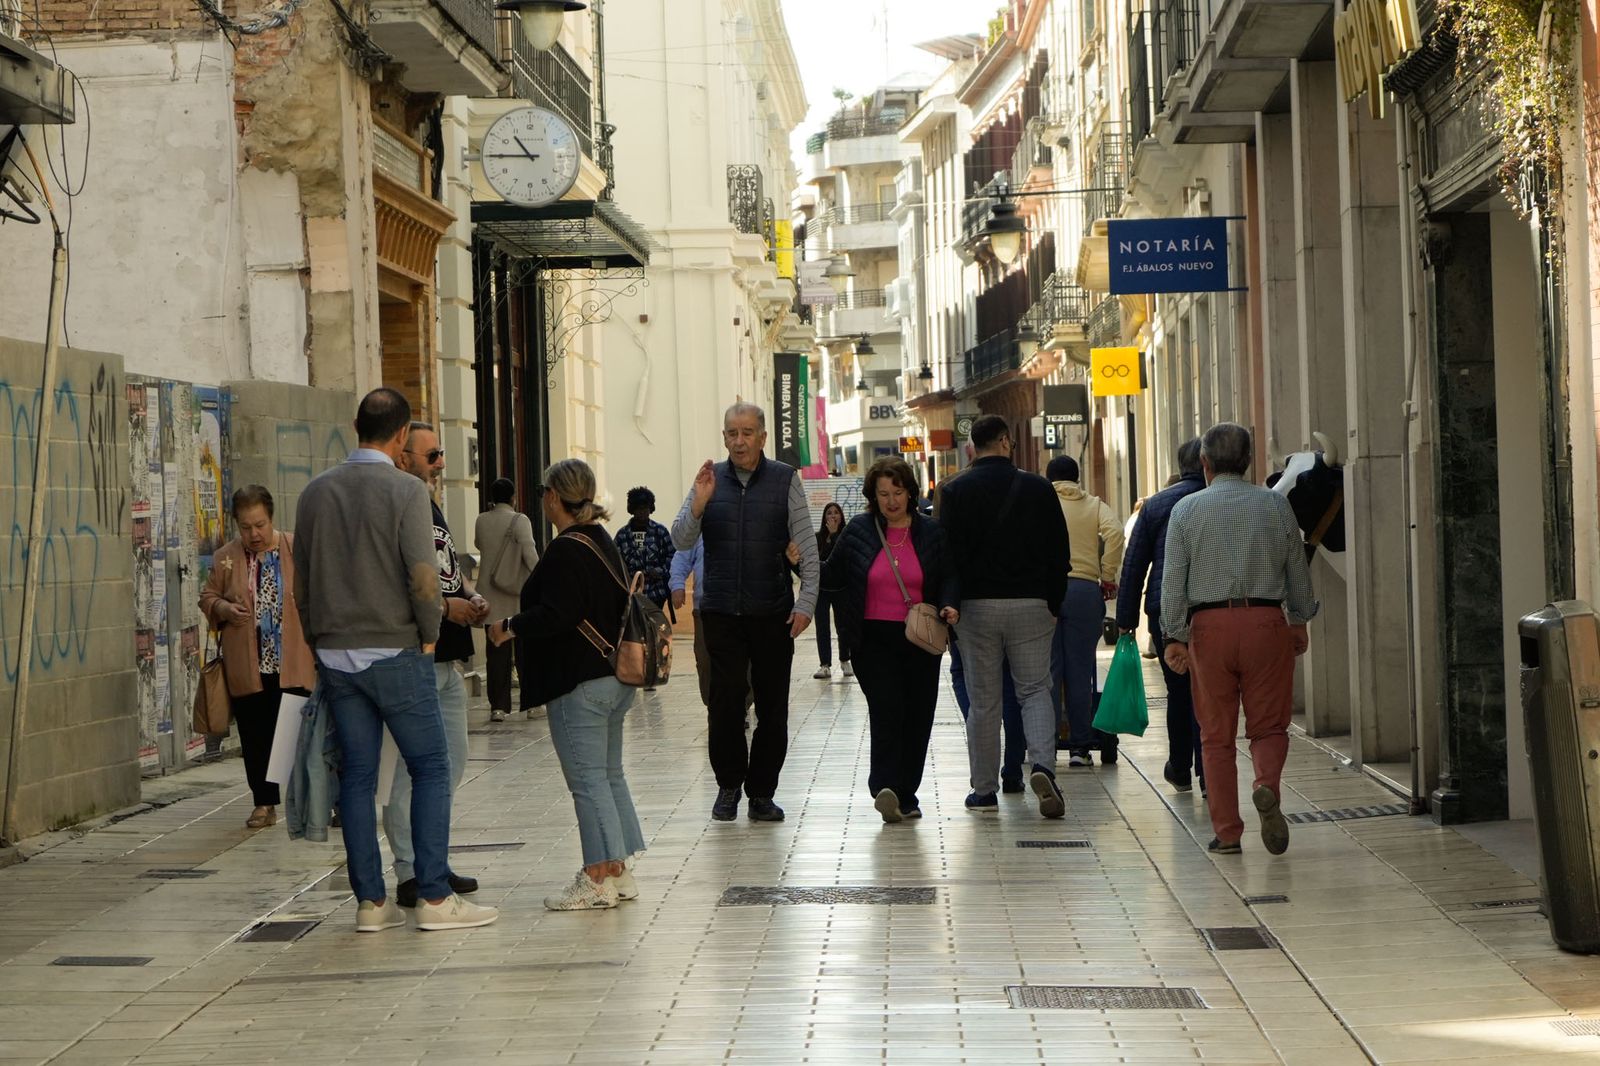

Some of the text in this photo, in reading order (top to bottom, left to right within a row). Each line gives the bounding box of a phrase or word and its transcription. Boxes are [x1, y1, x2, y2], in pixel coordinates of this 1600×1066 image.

[1119, 235, 1215, 254] NOTARÍA
[1136, 262, 1174, 272] ÁBALOS
[1178, 261, 1214, 271] NUEVO
[782, 373, 792, 449] BIMBA Y LOLA
[869, 404, 898, 420] BBV
